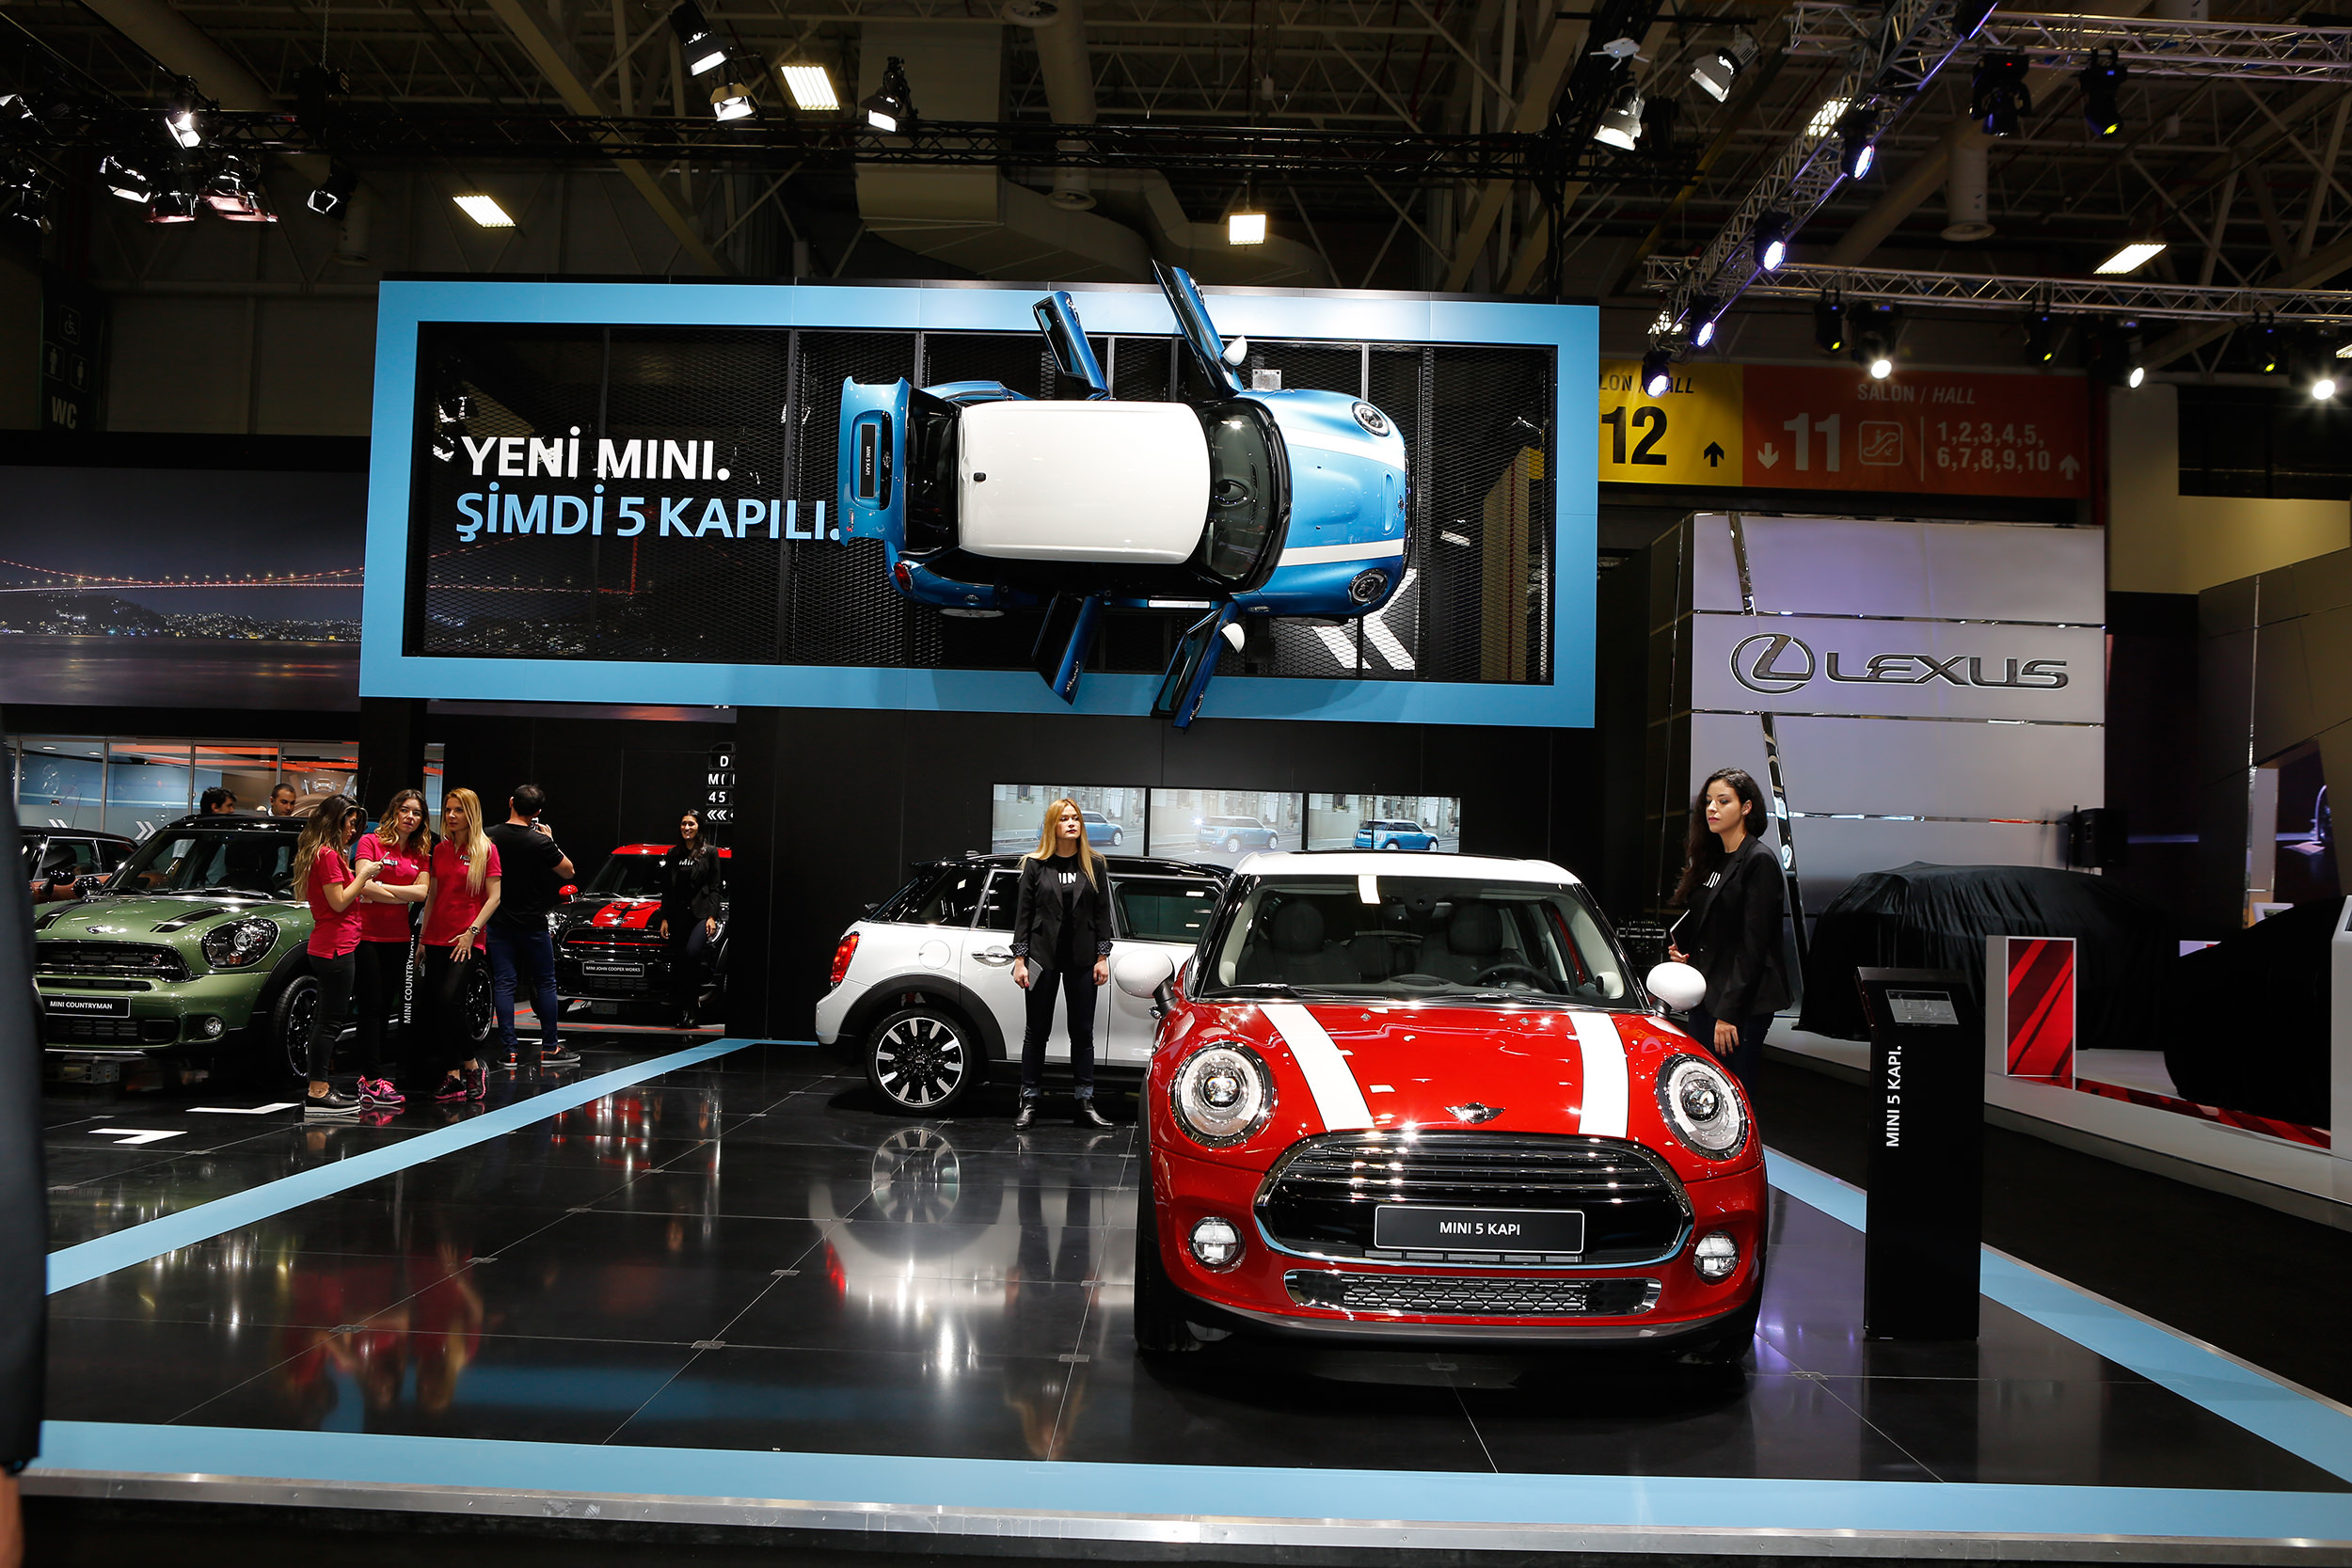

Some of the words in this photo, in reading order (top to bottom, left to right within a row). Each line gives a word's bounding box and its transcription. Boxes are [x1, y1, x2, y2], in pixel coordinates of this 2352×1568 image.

[1599, 374, 1632, 391] LON
[1857, 384, 1915, 402] SALON
[1932, 387, 1976, 404] HALL
[52, 396, 77, 430] WC
[1601, 405, 1668, 466] 12
[1784, 412, 1841, 472] 11
[461, 426, 580, 478] YENİ
[596, 438, 731, 482] MINI.
[455, 482, 605, 543] ŞİMDİ
[617, 496, 646, 537] 5
[660, 498, 842, 541] KAPILI.
[1826, 651, 2070, 689] LEXUS
[65, 1002, 113, 1010] COUNTRYMAN
[403, 1003, 412, 1024] MINI
[1887, 1046, 1901, 1089] KAPI.
[1887, 1095, 1900, 1104] 5
[1886, 1109, 1899, 1148] MINI
[1439, 1221, 1471, 1235] MINI
[1475, 1223, 1484, 1235] 5
[1487, 1223, 1520, 1236] KAPI
